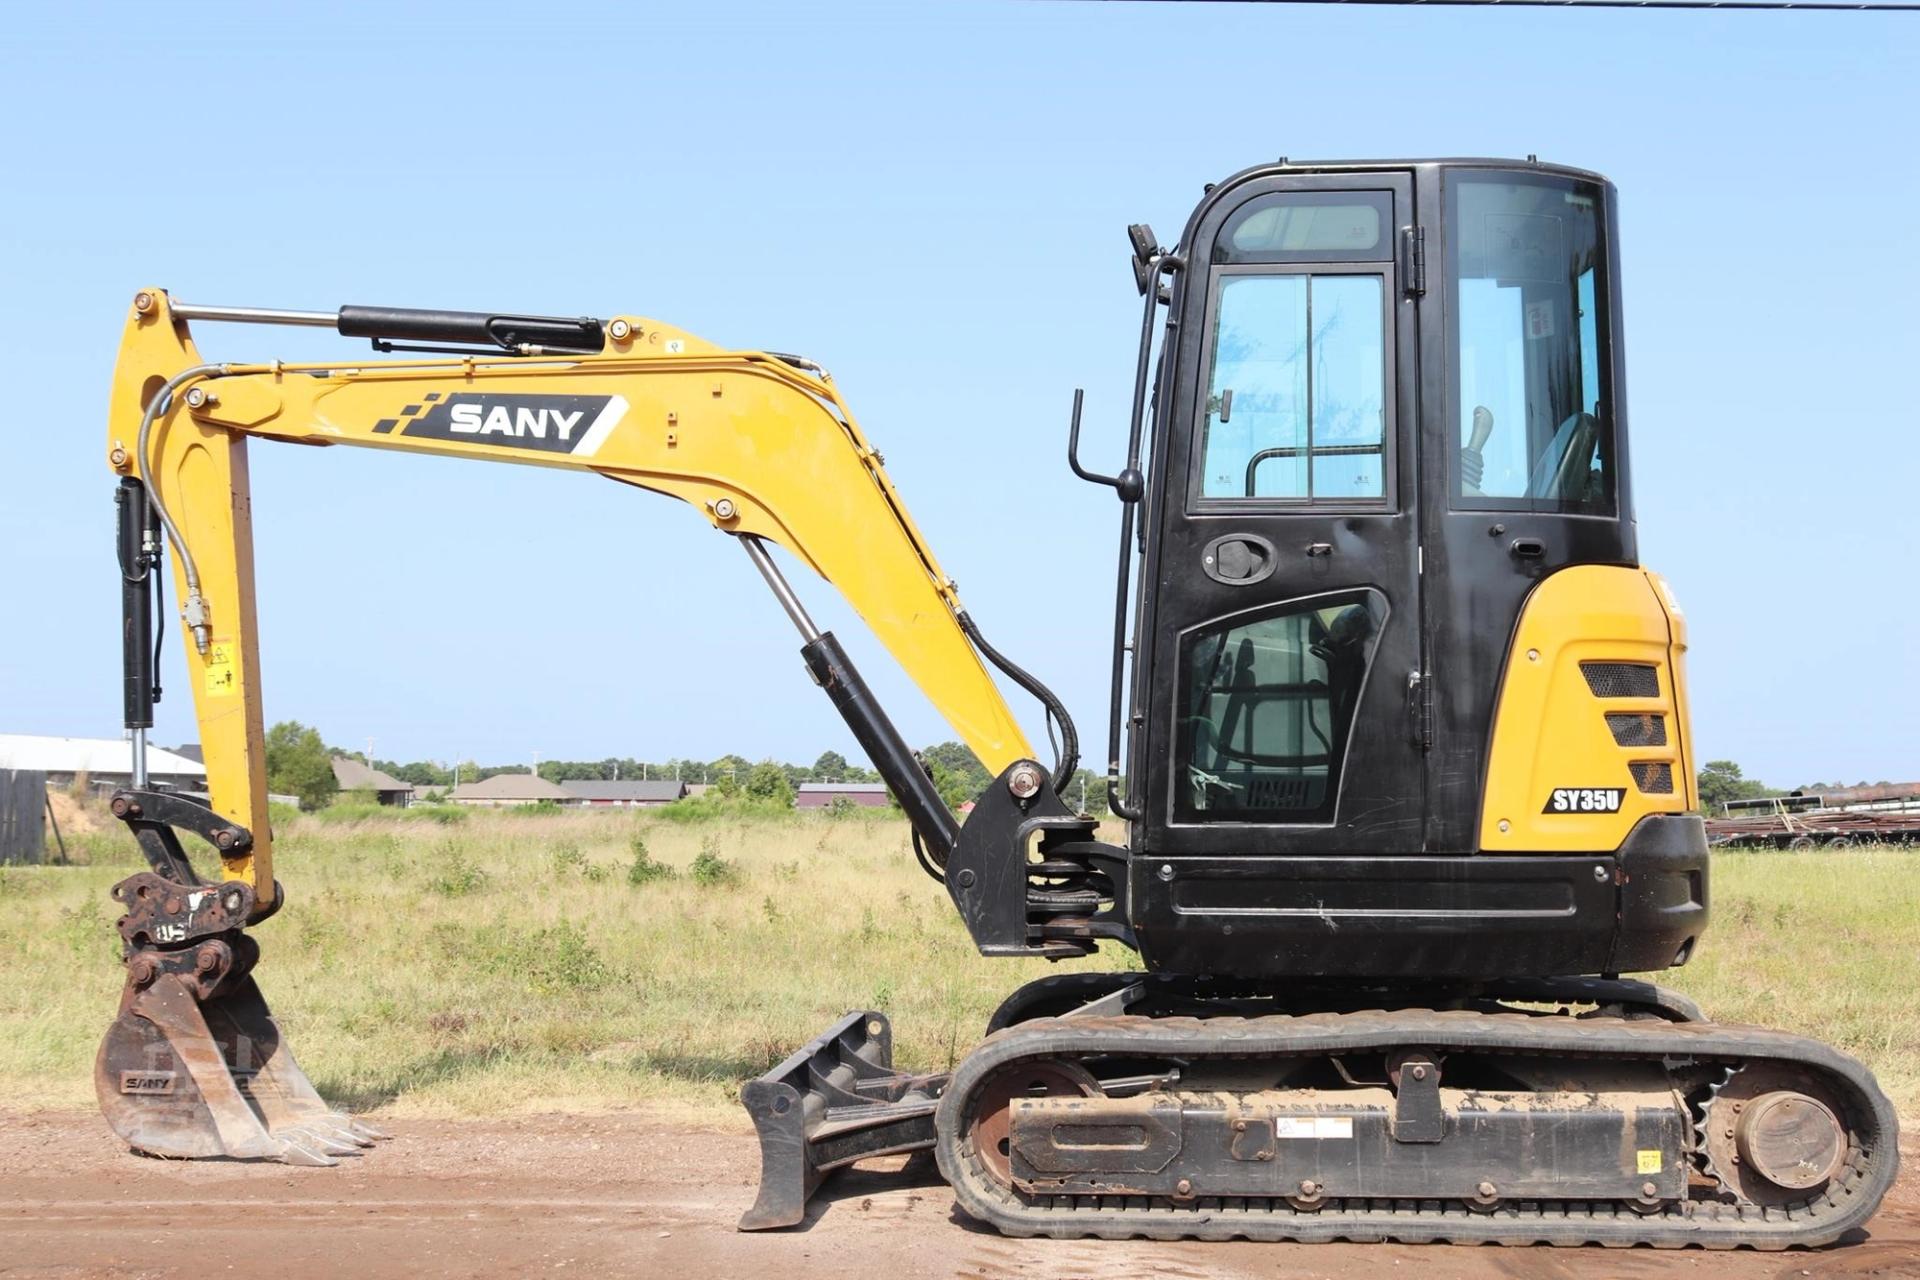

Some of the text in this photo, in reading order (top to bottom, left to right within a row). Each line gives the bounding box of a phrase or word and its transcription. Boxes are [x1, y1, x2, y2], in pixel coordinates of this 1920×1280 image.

[450, 403, 584, 440] SANY
[1553, 789, 1619, 811] SY35U
[126, 1078, 170, 1089] SANY
